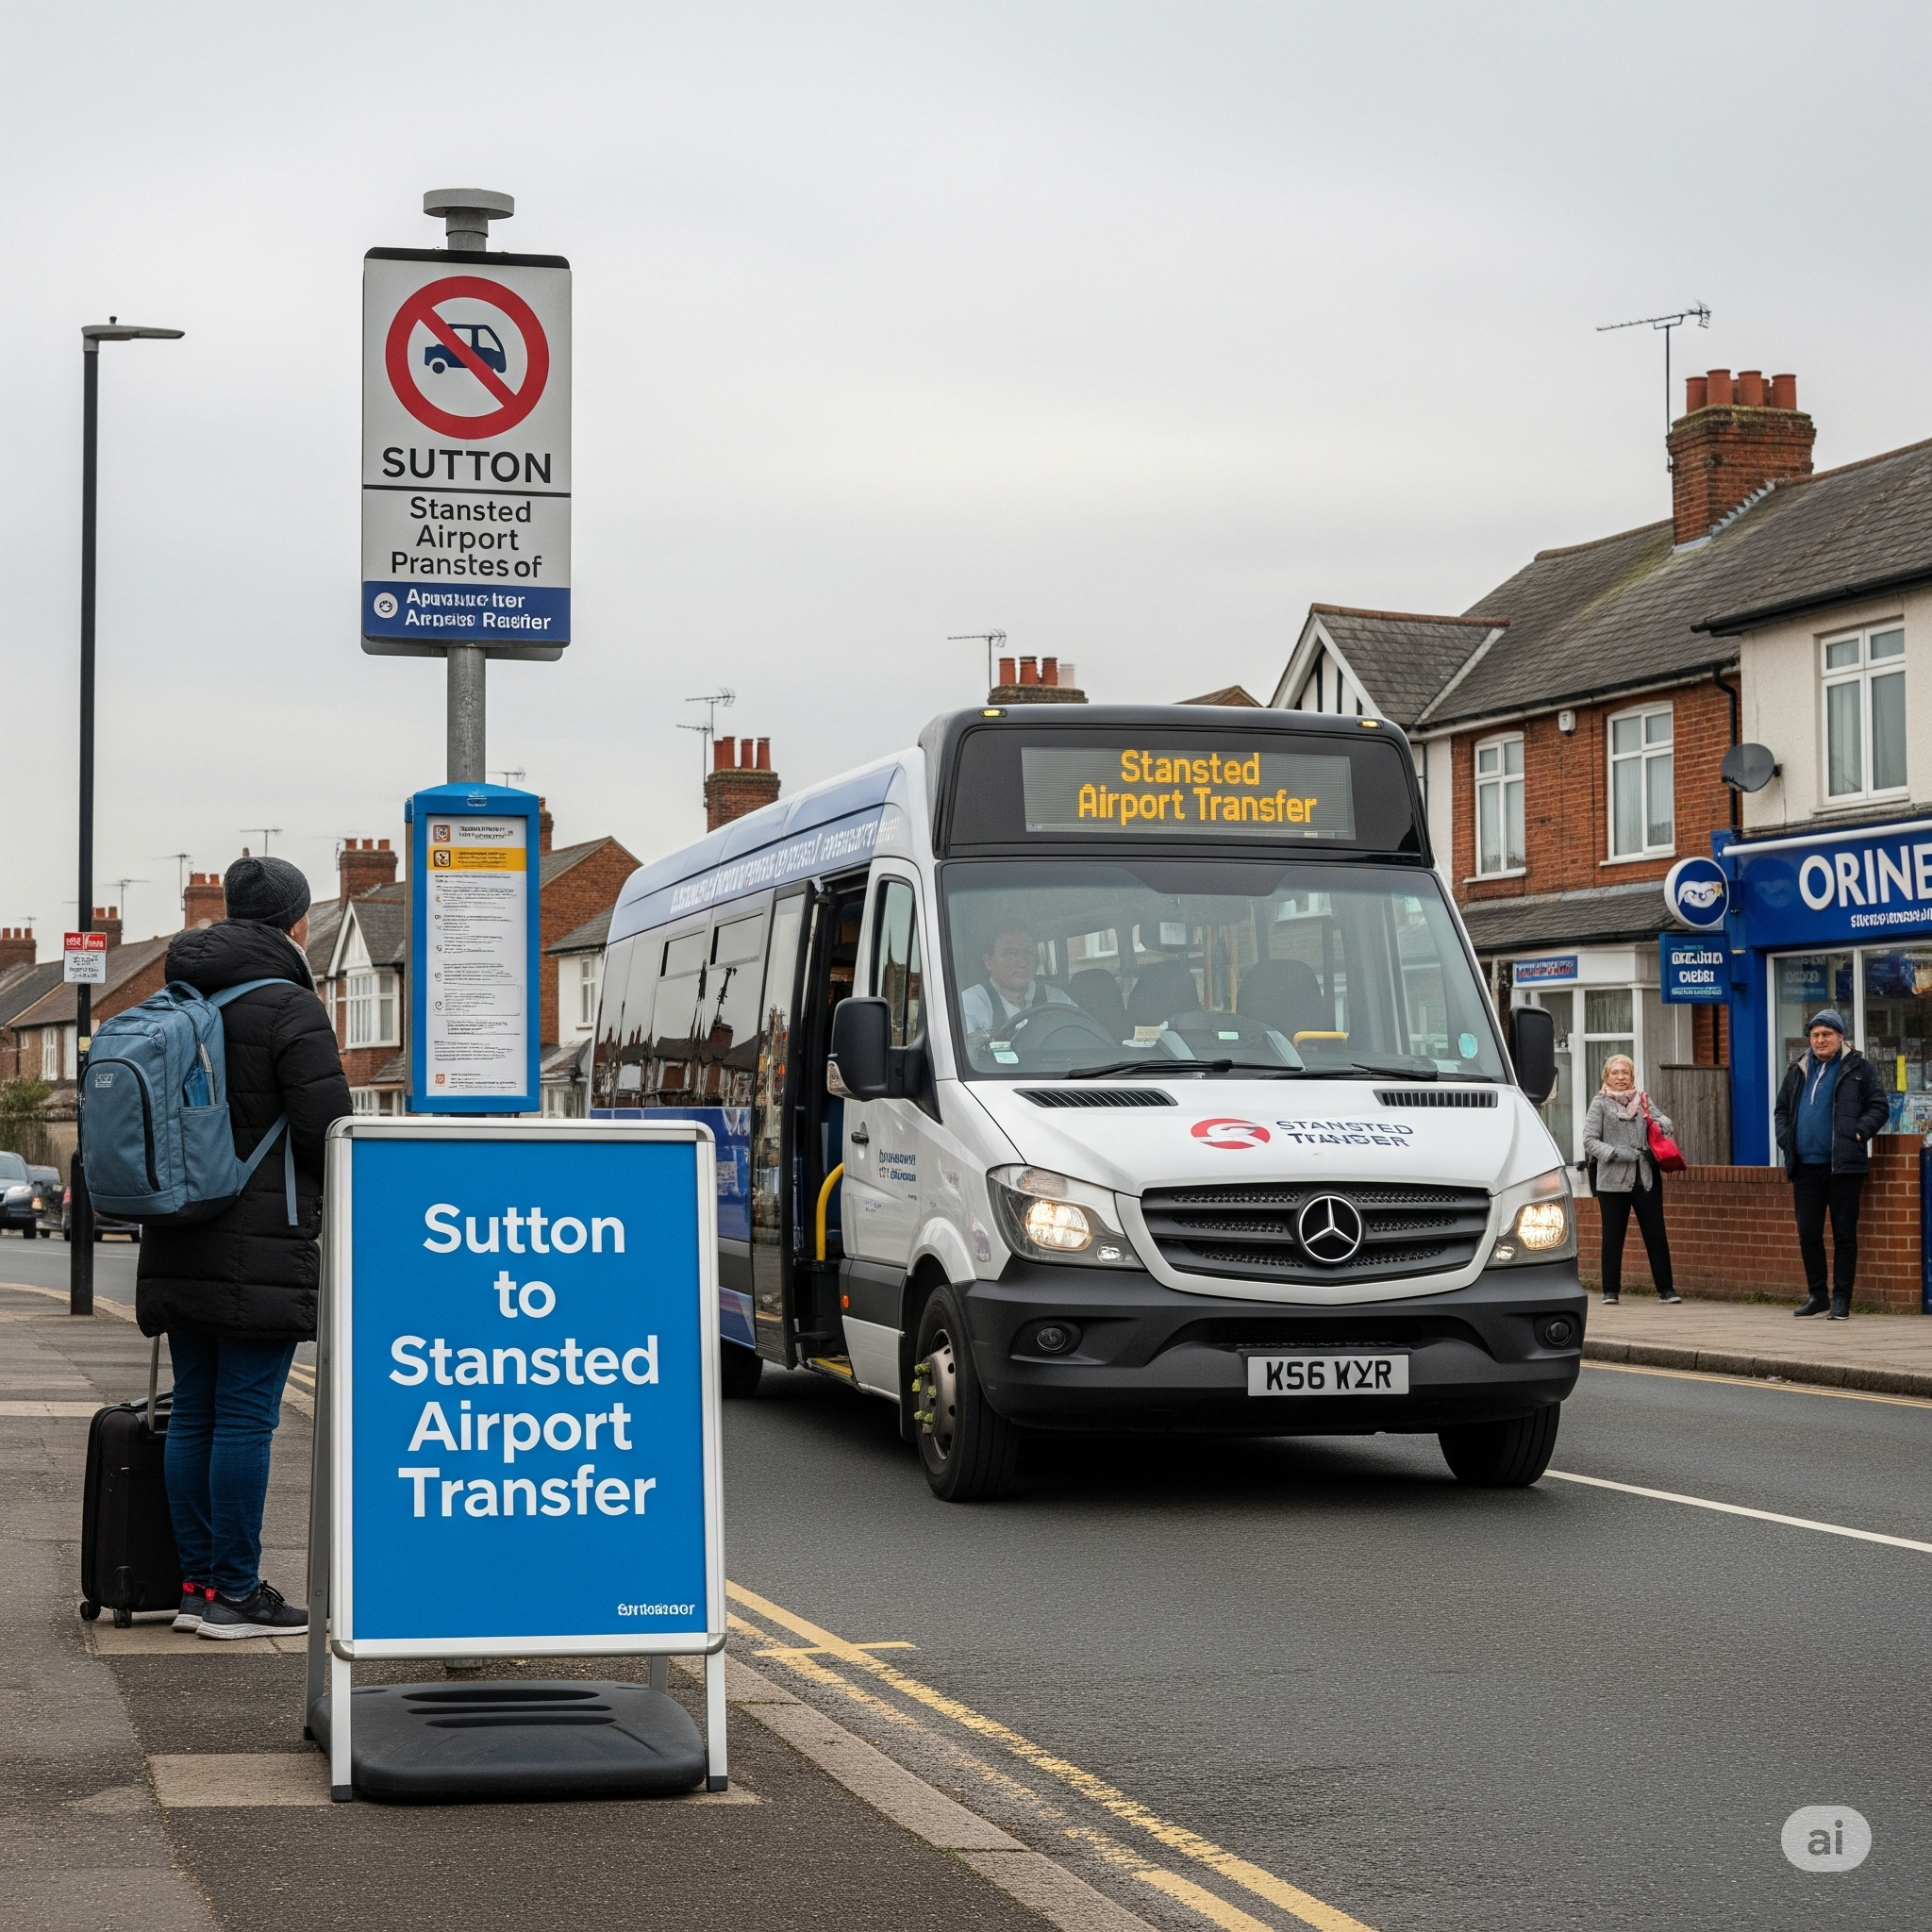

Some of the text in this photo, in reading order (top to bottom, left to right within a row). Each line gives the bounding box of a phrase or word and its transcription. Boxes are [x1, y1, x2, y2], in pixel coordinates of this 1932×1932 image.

[382, 446, 551, 484] SUTTON
[409, 495, 532, 524] Stansted
[415, 525, 520, 554] Airport
[1121, 749, 1260, 786] Stansted
[1078, 783, 1318, 826] Airport Transfer
[1275, 1121, 1414, 1135] STANSTED
[423, 1203, 625, 1254] Sutton
[493, 1271, 557, 1319] to
[389, 1335, 659, 1386] Stansted
[408, 1400, 633, 1463] Airport
[398, 1464, 657, 1518] Transfer
